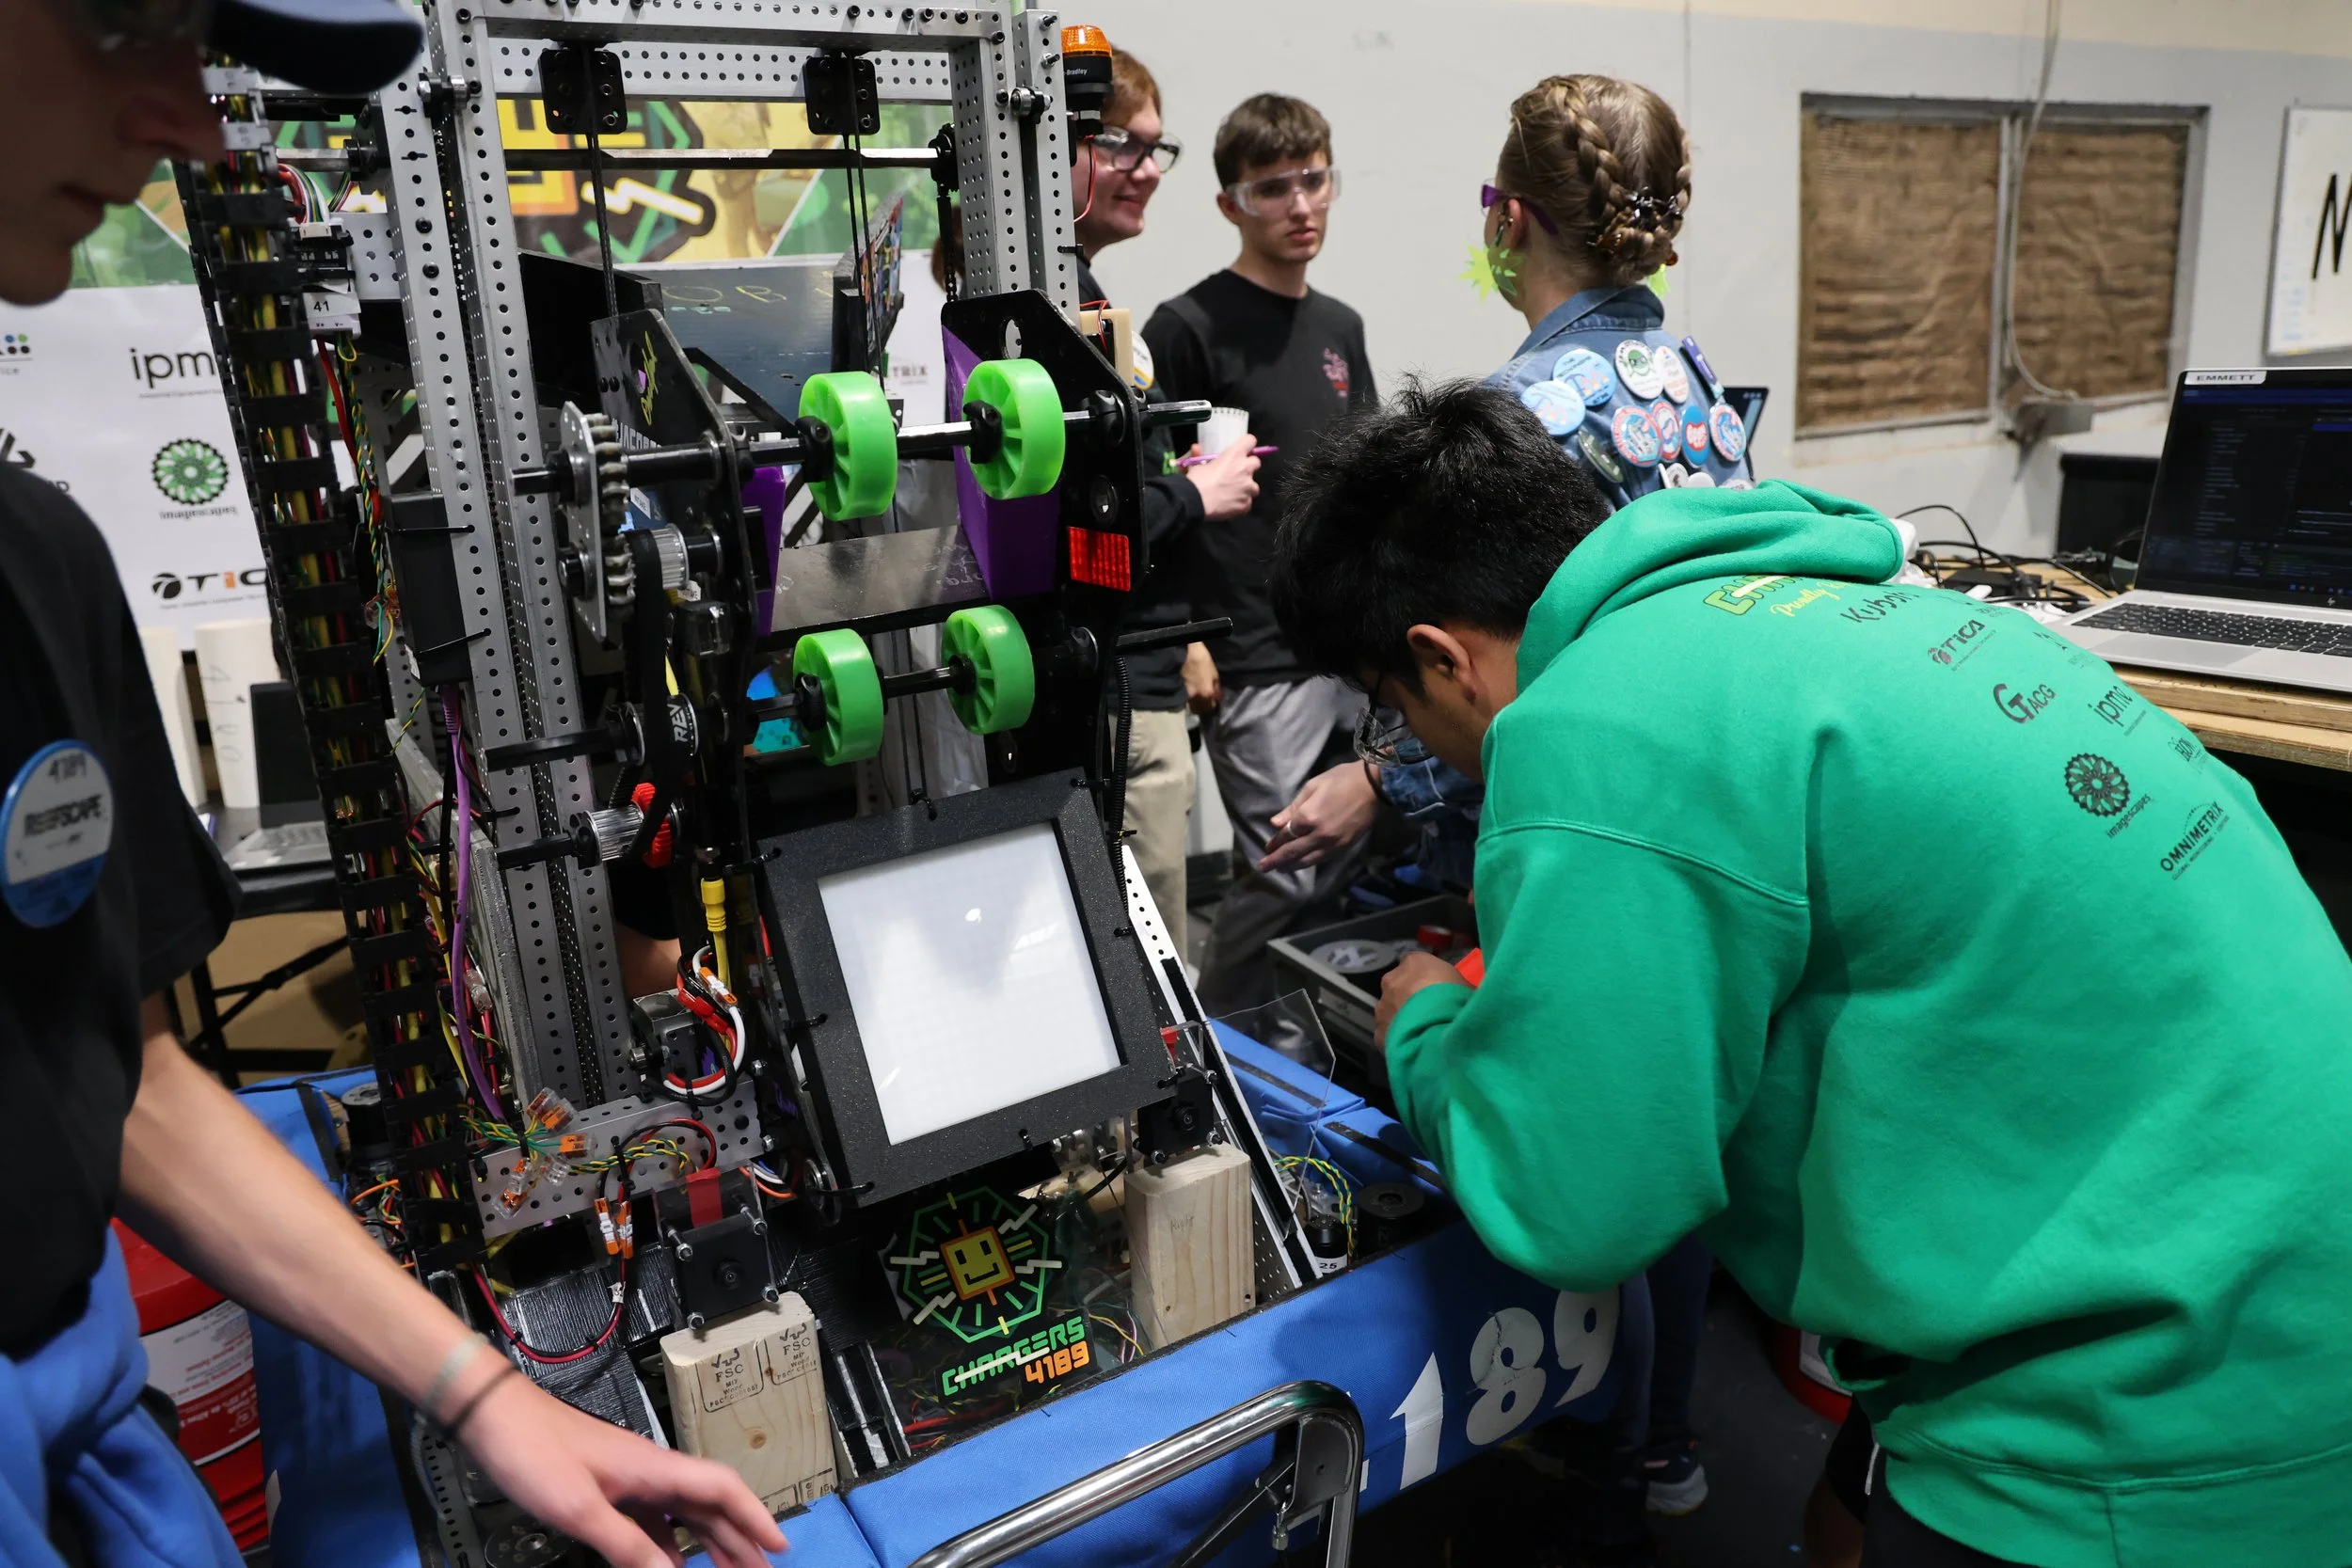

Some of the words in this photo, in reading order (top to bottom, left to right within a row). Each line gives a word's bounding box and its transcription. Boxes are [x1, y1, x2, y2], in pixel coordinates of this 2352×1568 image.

[313, 300, 330, 311] 41
[130, 347, 216, 389] ipm
[667, 704, 690, 743] REV
[2106, 793, 2152, 839] imagescapes
[2160, 800, 2225, 873] OMNIMETRIX
[783, 1337, 811, 1355] FSC
[942, 1316, 1086, 1397] CHARGERS
[1025, 1340, 1091, 1385] 4189
[715, 1364, 744, 1383] FSC
[1359, 1290, 1620, 1493] 189
